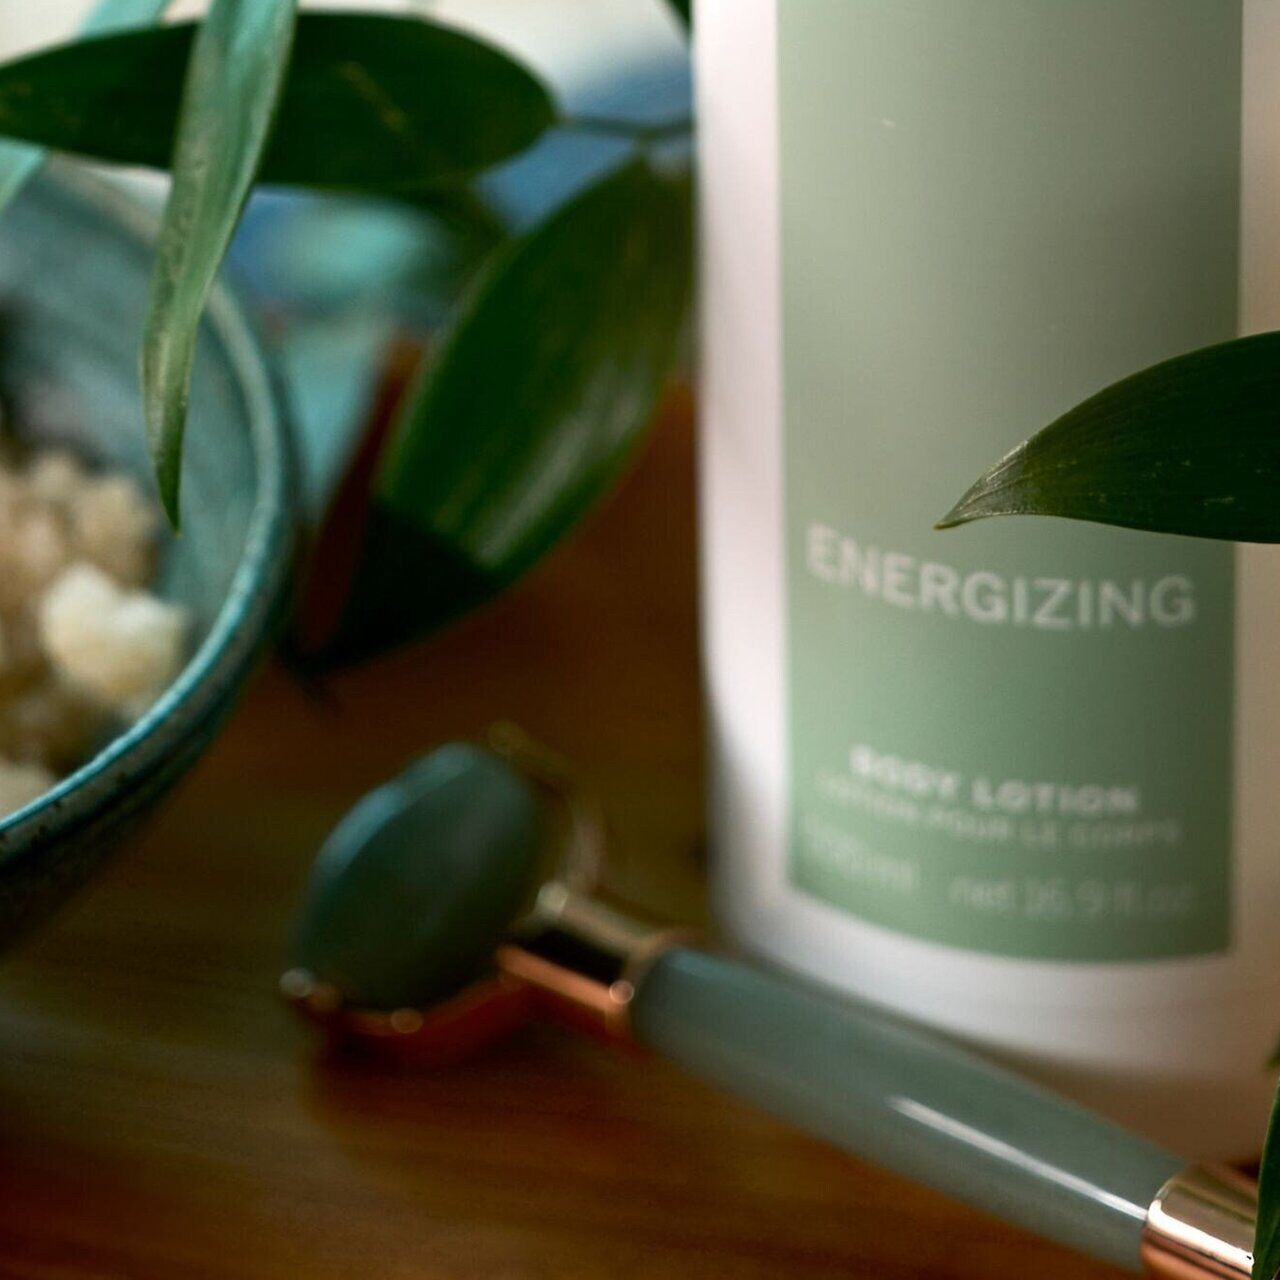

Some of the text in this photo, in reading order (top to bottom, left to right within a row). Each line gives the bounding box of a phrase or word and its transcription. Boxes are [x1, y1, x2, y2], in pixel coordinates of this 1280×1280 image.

[806, 522, 1196, 629] ENERGIZING
[849, 743, 1140, 817] BODY LOTION
